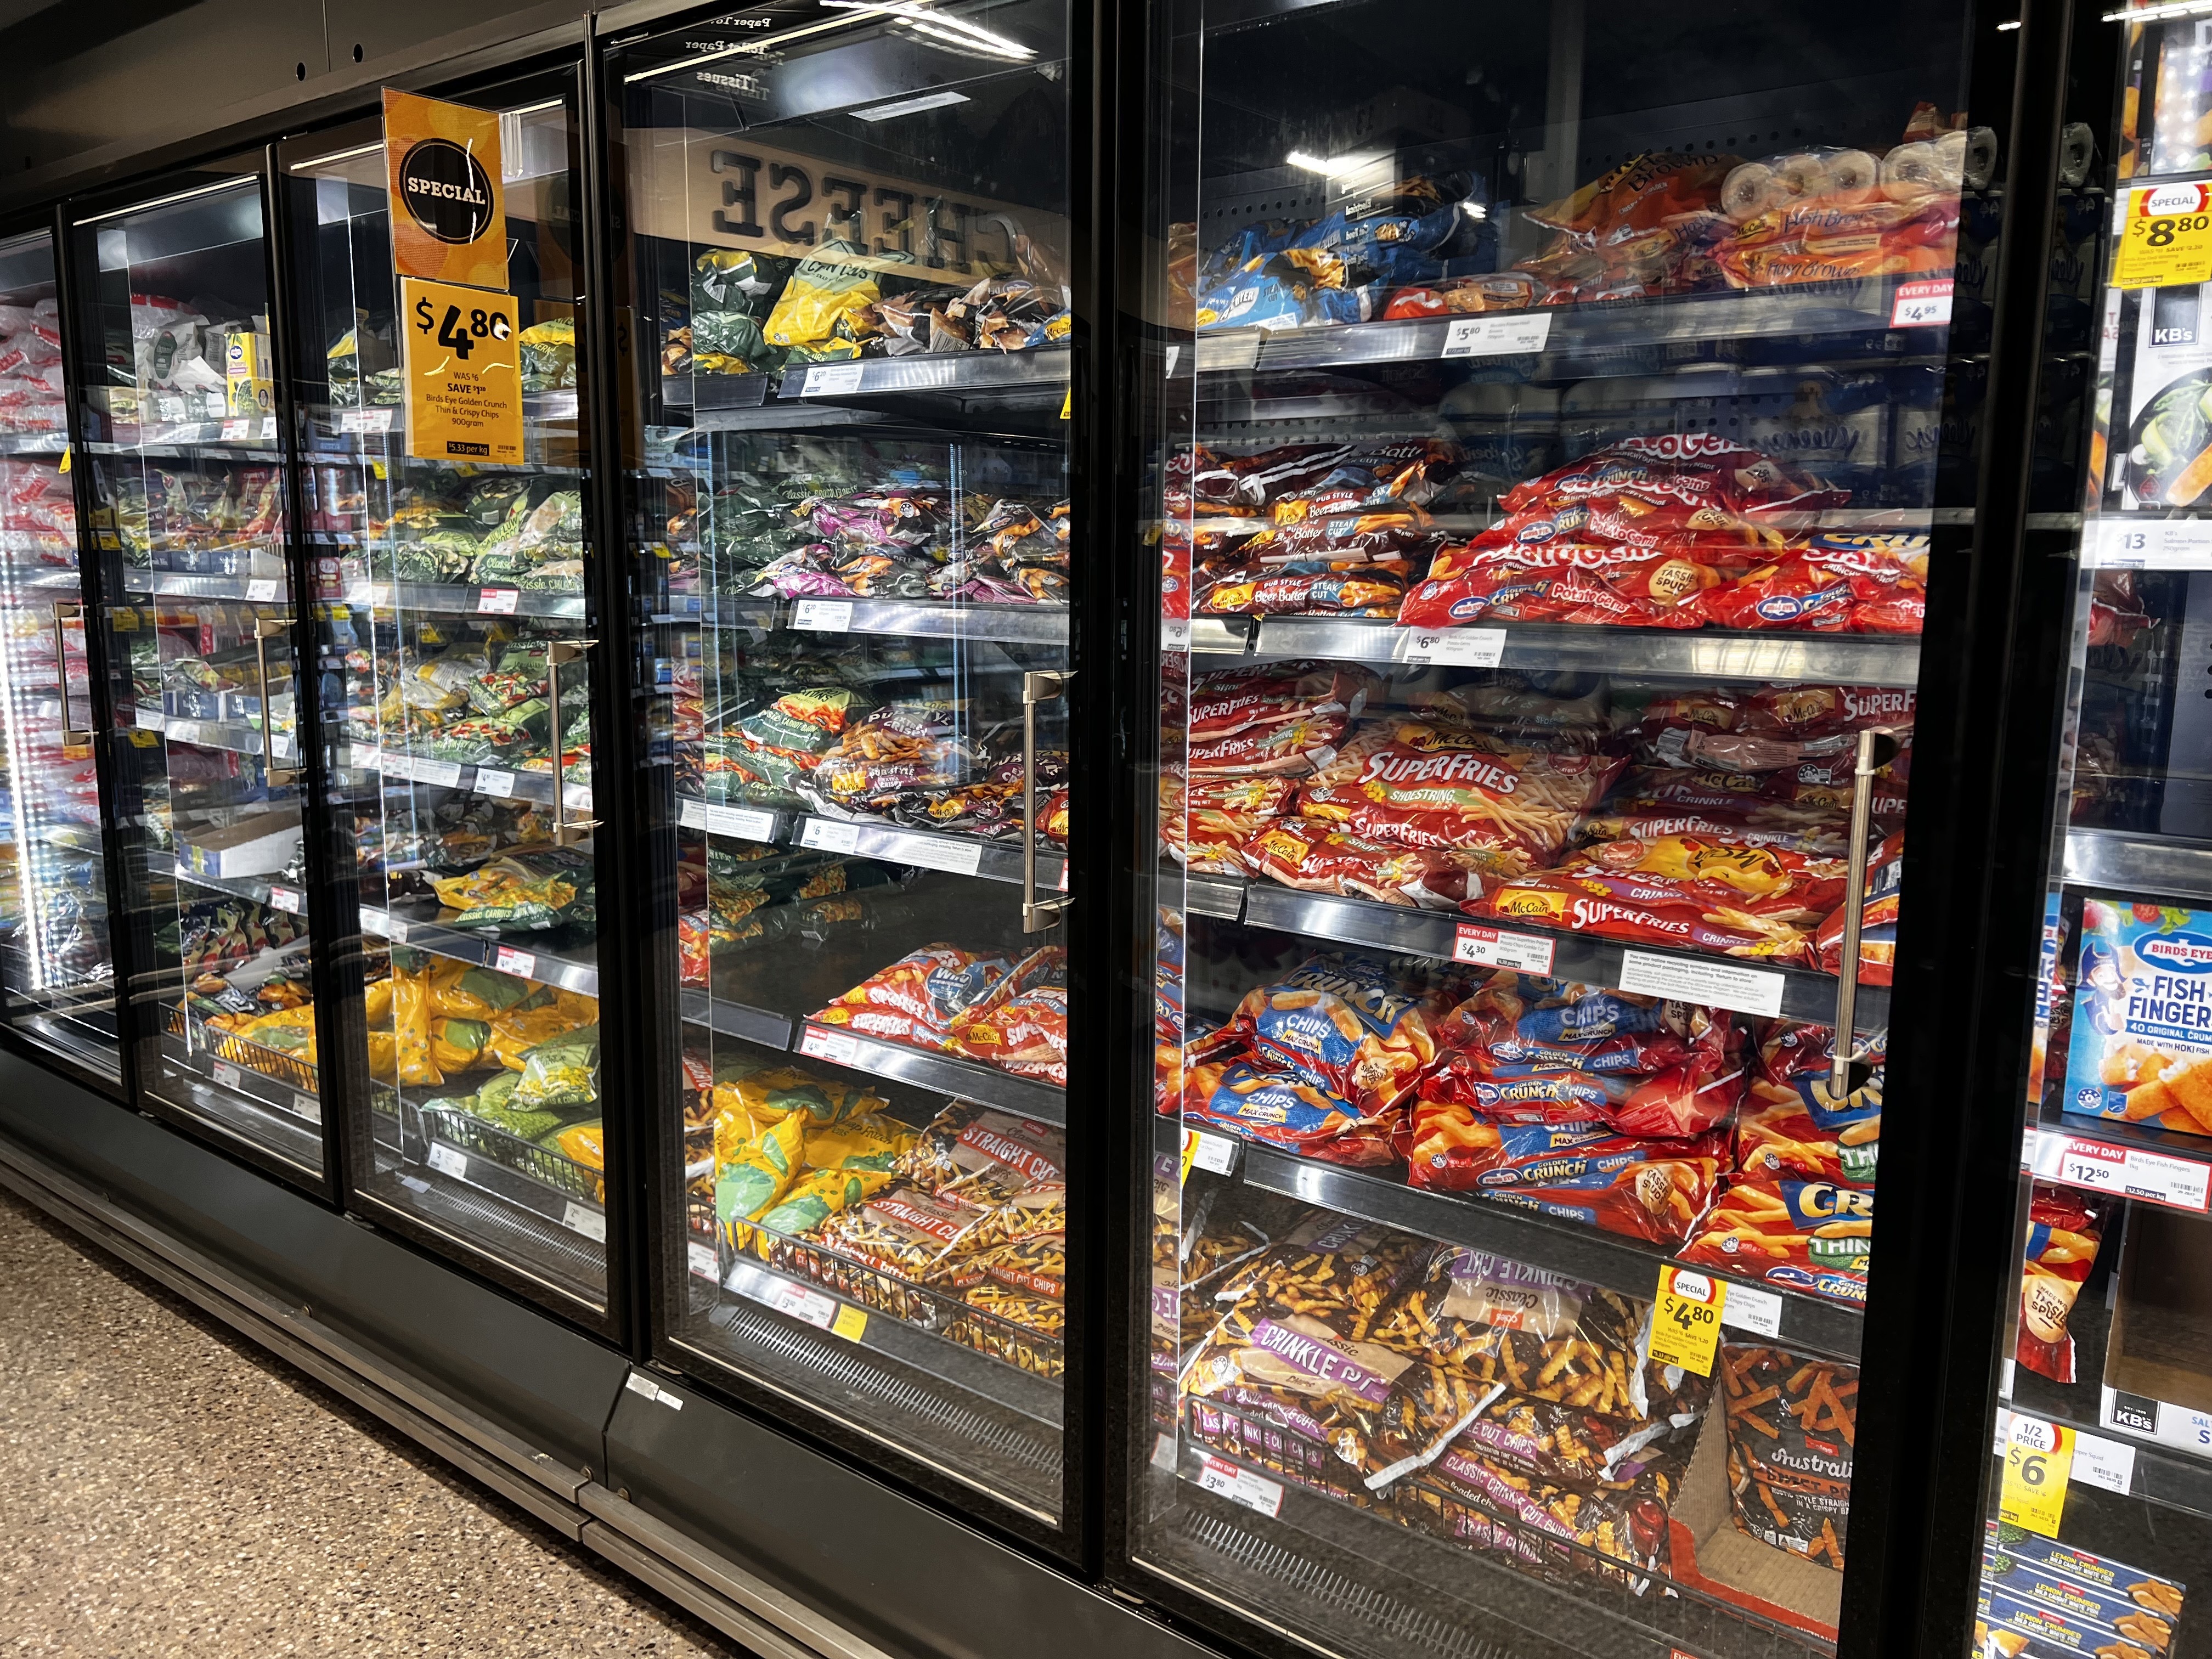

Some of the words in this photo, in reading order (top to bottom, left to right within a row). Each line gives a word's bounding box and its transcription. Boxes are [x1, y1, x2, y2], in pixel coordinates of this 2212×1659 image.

[408, 176, 486, 206] SPECIAL
[2151, 196, 2196, 208] SPECIAL
[1898, 285, 1931, 297] EVERY
[1933, 283, 1954, 294] DAY
[2154, 328, 2194, 343] KB's
[453, 371, 471, 380] WAS
[471, 373, 479, 381] $6
[447, 383, 471, 394] SAVE
[426, 394, 444, 403] Birds
[445, 396, 457, 405] Eye
[458, 397, 483, 407] Golden
[484, 399, 507, 409] Crunch
[435, 405, 451, 414] Thin
[459, 408, 479, 418] Crispy
[481, 410, 499, 419] Chips
[452, 417, 484, 428] 900gram
[449, 443, 465, 453] $5.33
[466, 445, 477, 454] per
[479, 447, 488, 456] kg
[1332, 492, 1354, 500] STYLE
[1329, 520, 1354, 528] STEAK
[1328, 528, 1345, 536] CUT
[1264, 580, 1278, 589] PUB
[1280, 579, 1302, 587] STYLE
[1312, 583, 1339, 592] STEAK
[1255, 590, 1277, 602] Beer
[1278, 589, 1308, 602] Batter
[1312, 590, 1328, 599] CUT
[1359, 751, 1519, 794] SUPERFRIES
[1390, 789, 1454, 802] SHOESTRING
[1355, 817, 1438, 847] SUPERFRIES
[1630, 816, 1733, 838] SUPERFRIES
[1747, 832, 1789, 844] CRINKLE
[1268, 840, 1295, 861] McCain
[1510, 901, 1549, 915] McCain
[1571, 899, 1690, 934] SUPERFRIES
[1702, 933, 1750, 945] CRINKLE
[1459, 927, 1481, 936] EVERY
[1482, 931, 1497, 939] DAY
[2152, 944, 2188, 957] BIRDS
[2191, 947, 2212, 959] EYE
[2153, 975, 2206, 1001] FISH
[1560, 1003, 1618, 1025] CHIPS
[2129, 996, 2212, 1028] FINGER
[1287, 1014, 1331, 1039] CHIPS
[2130, 1023, 2145, 1032] 40
[2147, 1025, 2184, 1039] ORIGINAL
[972, 1031, 998, 1041] McCain
[1563, 1031, 1582, 1040] MAX
[2137, 1038, 2155, 1047] MADE
[2157, 1041, 2173, 1049] WITH
[2175, 1043, 2195, 1053] HOKI
[1539, 1050, 1568, 1058] GOLDEN
[1593, 1054, 1630, 1069] CHIPS
[1300, 1070, 1325, 1087] CHIPS
[1500, 1084, 1556, 1101] CRUNCH
[1246, 1092, 1296, 1110] CHIPS
[1258, 1110, 1283, 1120] CRUNCH
[1027, 1123, 1043, 1133] coles
[1006, 1127, 1042, 1147] Classic
[1554, 1137, 1573, 1146] MAX
[963, 1127, 1032, 1169] STRAIGHT
[1030, 1156, 1060, 1181] CUT
[2067, 1141, 2098, 1156] EVERY
[2102, 1147, 2123, 1160] DAY
[1538, 1160, 1568, 1168] GOLDEN
[1598, 1157, 1635, 1170] CHIPS
[2130, 1155, 2143, 1164] Birds
[2145, 1158, 2155, 1167] Eye
[2157, 1160, 2169, 1169] Fish
[2170, 1161, 2190, 1173] Fingers
[989, 1164, 1012, 1181] CHIPS
[1523, 1161, 1587, 1182] CRUNCH
[1485, 1176, 1503, 1184] BIRDS
[2127, 1186, 2145, 1196] $12.50
[2146, 1190, 2155, 1199] per
[2157, 1192, 2165, 1200] kg
[873, 1200, 938, 1231] STRAIGHT
[1549, 1206, 1584, 1221] CHIPS
[893, 1223, 915, 1235] CHIPS
[1034, 1278, 1056, 1294] CHIPS
[1676, 1282, 1707, 1297] SPECIAL
[1486, 1286, 1538, 1309] Classic
[1729, 1297, 1743, 1306] Crispy
[1735, 1291, 1751, 1300] Golden
[1752, 1296, 1768, 1305] Crunch
[1496, 1313, 1518, 1324] coles
[1685, 1332, 1697, 1340] SAVE
[1261, 1325, 1339, 1380] CRINKLE
[2116, 1409, 2153, 1430] KB's
[2023, 1424, 2042, 1437] 1/2
[1481, 1425, 1502, 1442] CUT
[1504, 1433, 1534, 1455] CHIPS
[2016, 1434, 2046, 1450] PRICE
[2088, 1452, 2104, 1461] Squid
[1223, 1464, 1236, 1475] DAY
[2009, 1447, 2047, 1486] $6
[1446, 1457, 1485, 1483] CLASSIC
[1523, 1506, 1544, 1524] CUT
[1451, 1482, 1481, 1503] loaded
[1771, 1487, 1794, 1498] RUSTIC
[1796, 1494, 1817, 1504] STYLE
[2024, 1486, 2040, 1495] SAVE
[1813, 1504, 1837, 1514] CRISPY
[2051, 1551, 2076, 1564] LEMON
[2079, 1561, 2115, 1577] CRUMBED
[2063, 1561, 2083, 1571] CAUGHT
[2036, 1583, 2062, 1596] LEMON
[2064, 1593, 2101, 1610] CRUMBED
[2049, 1593, 2068, 1603] CAUGHT
[2016, 1611, 2042, 1624] LEMON
[2045, 1621, 2082, 1639] CRUMBED
[2028, 1621, 2047, 1632] CAUGHT
